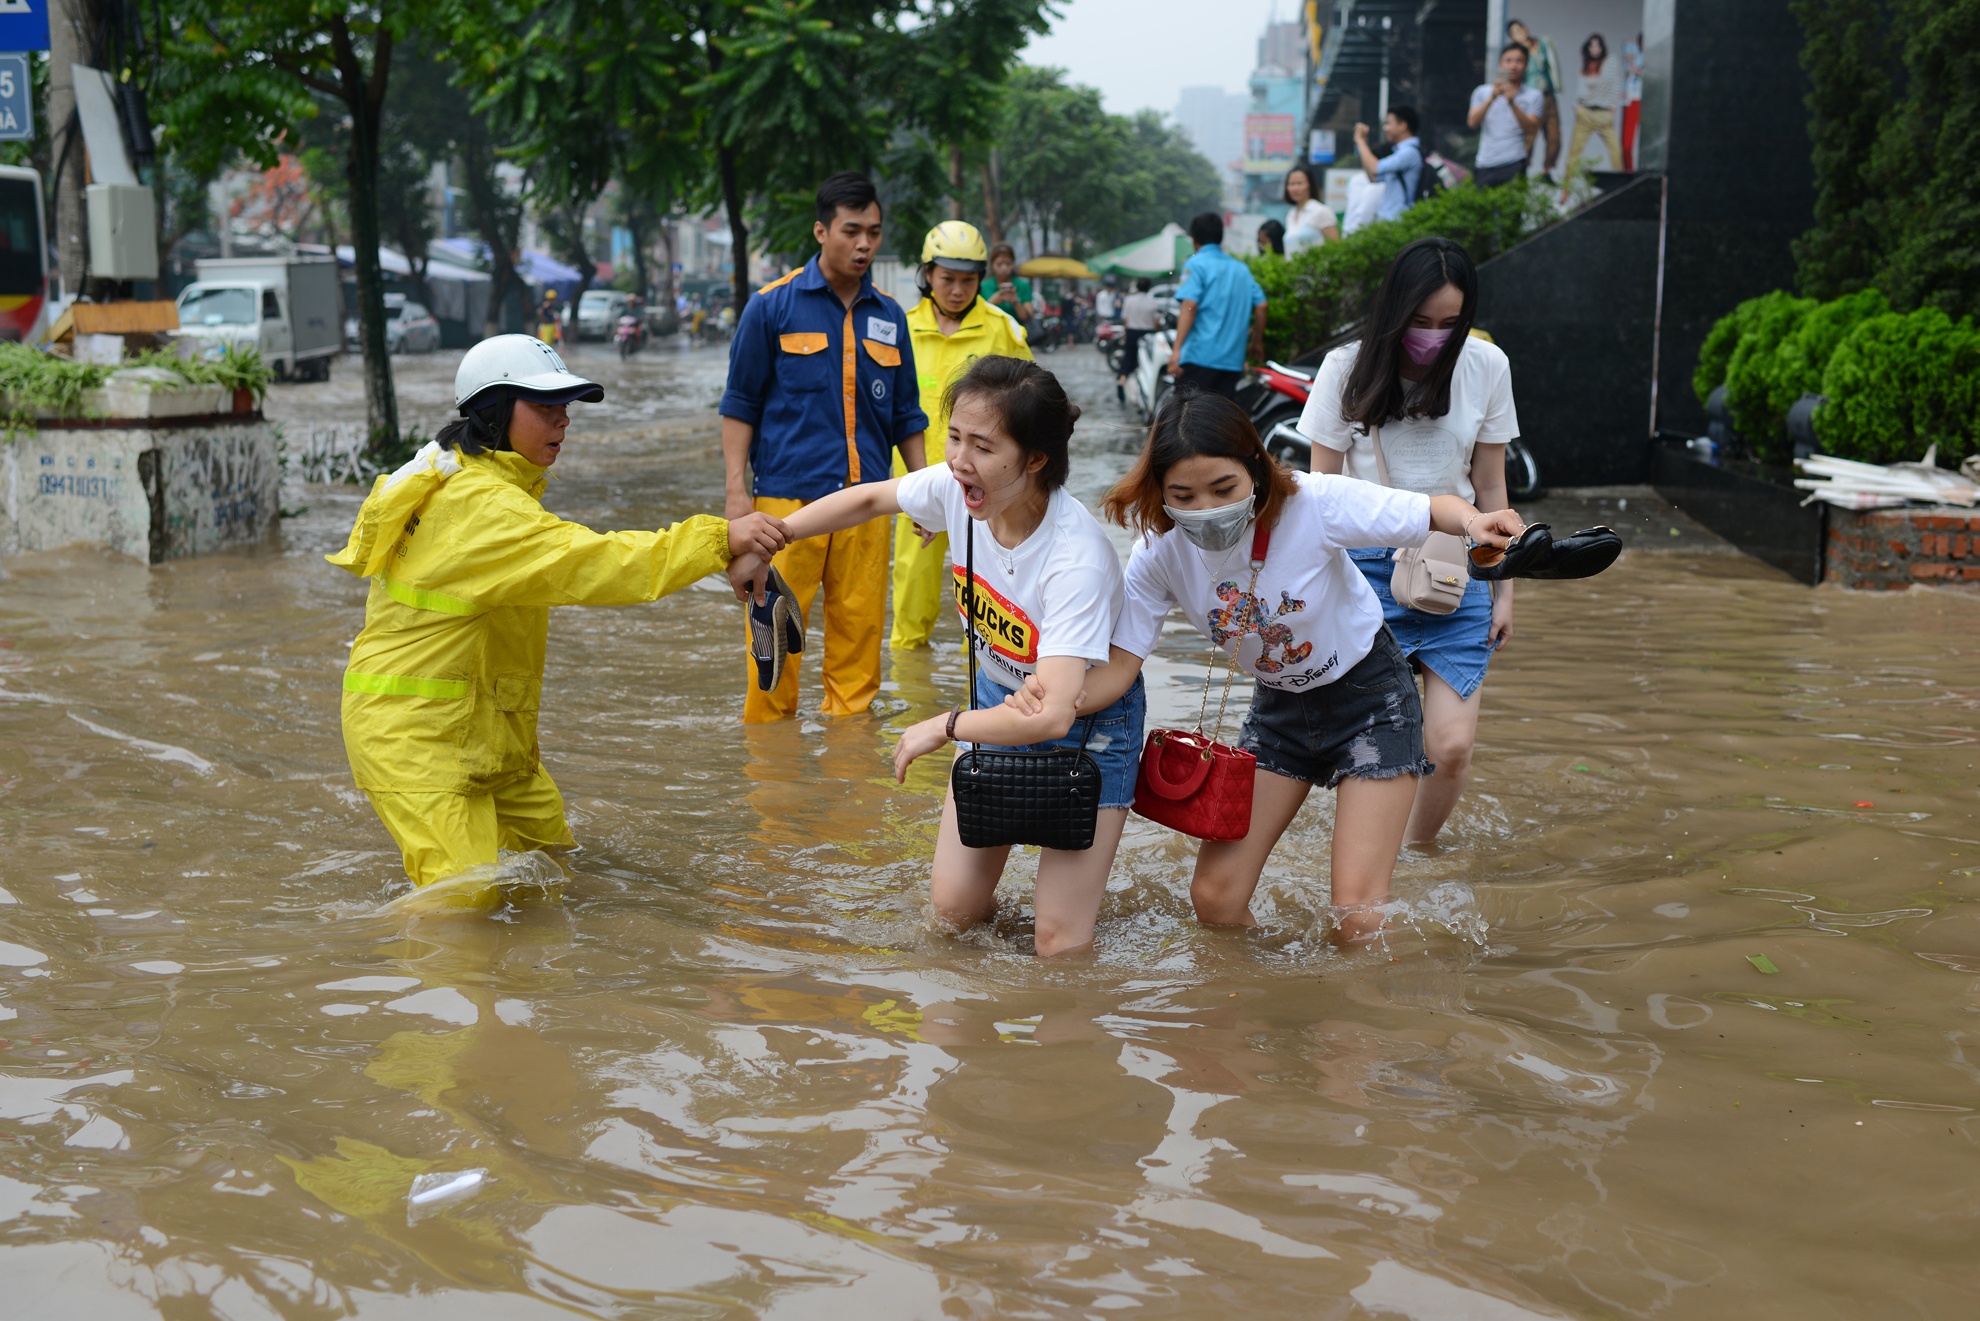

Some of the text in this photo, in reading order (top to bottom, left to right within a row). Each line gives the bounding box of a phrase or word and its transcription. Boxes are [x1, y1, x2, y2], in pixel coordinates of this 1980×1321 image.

[0, 106, 18, 130] À
[1402, 440, 1446, 449] ALPHABET
[1410, 449, 1454, 457] NUMBERS
